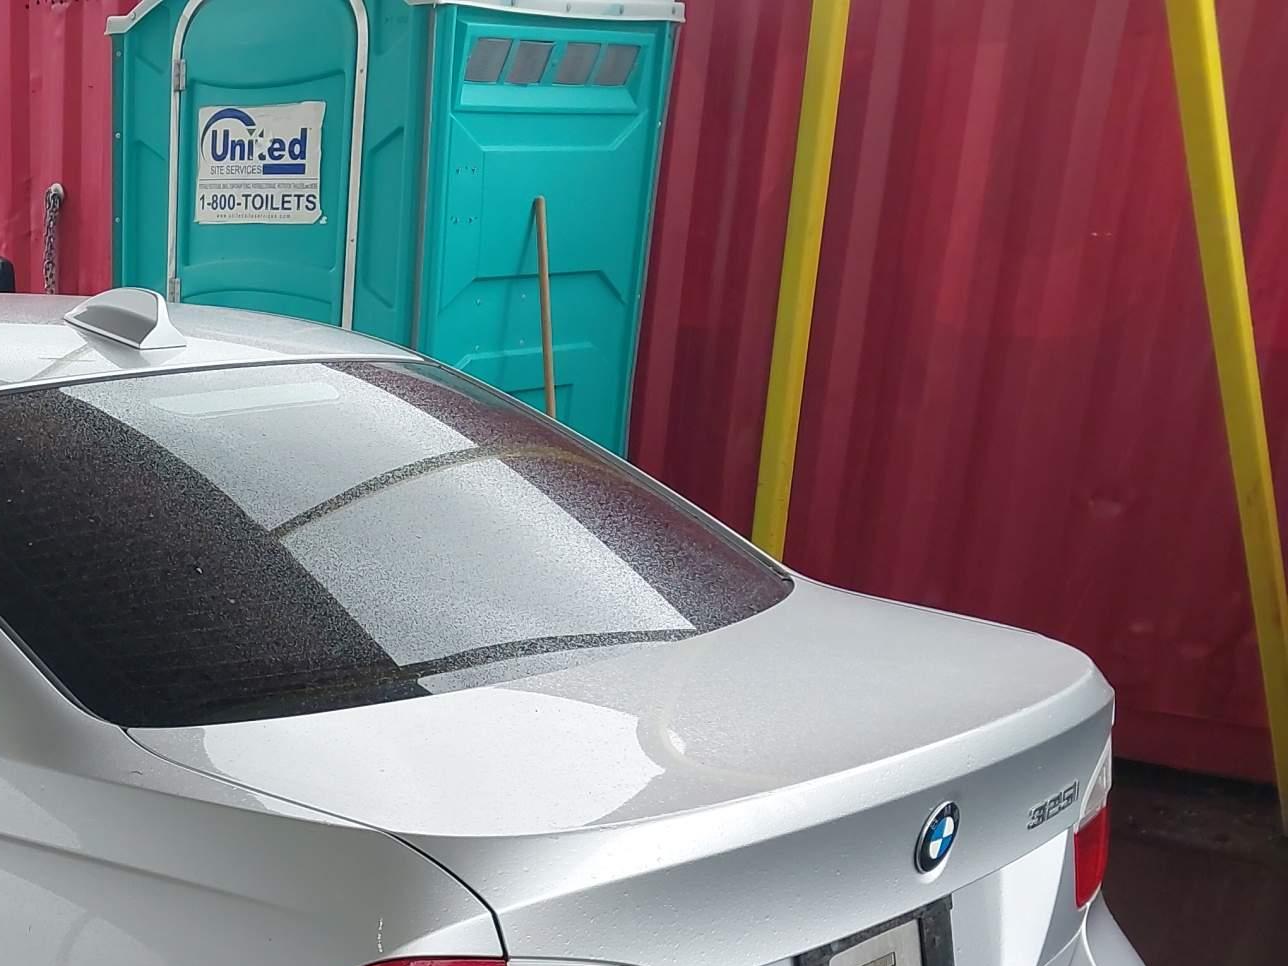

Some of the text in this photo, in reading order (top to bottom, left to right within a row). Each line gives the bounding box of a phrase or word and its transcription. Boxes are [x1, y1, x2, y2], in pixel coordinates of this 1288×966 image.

[210, 164, 262, 175] SITE SERVICES
[199, 193, 317, 211] 1-800-TOILETS
[1027, 780, 1080, 830] 325i
